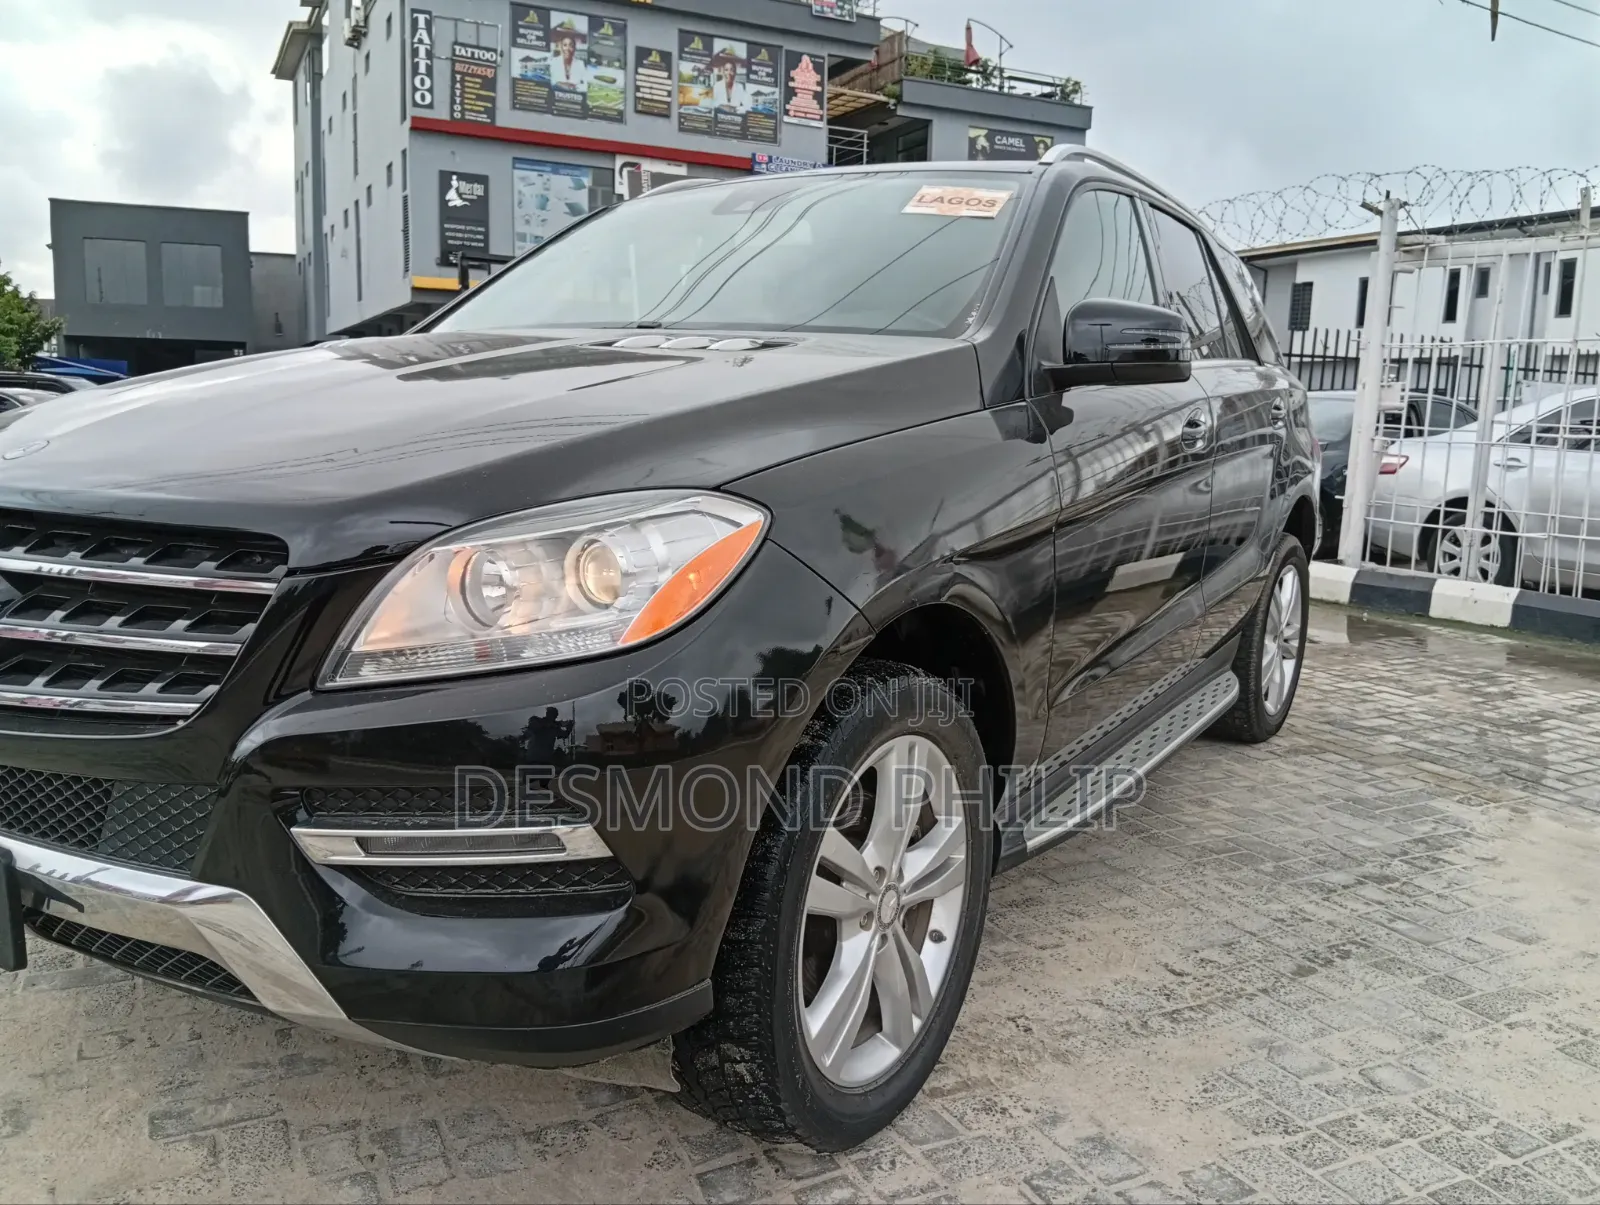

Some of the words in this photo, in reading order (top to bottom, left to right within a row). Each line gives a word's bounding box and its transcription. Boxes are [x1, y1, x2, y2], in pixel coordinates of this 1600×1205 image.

[412, 13, 432, 105] TATTOO
[453, 45, 496, 61] TATTOO
[453, 74, 462, 119] TATTOO
[994, 135, 1026, 147] CAMEL
[772, 155, 815, 168] LAUNDRY
[916, 194, 998, 208] LAGOS
